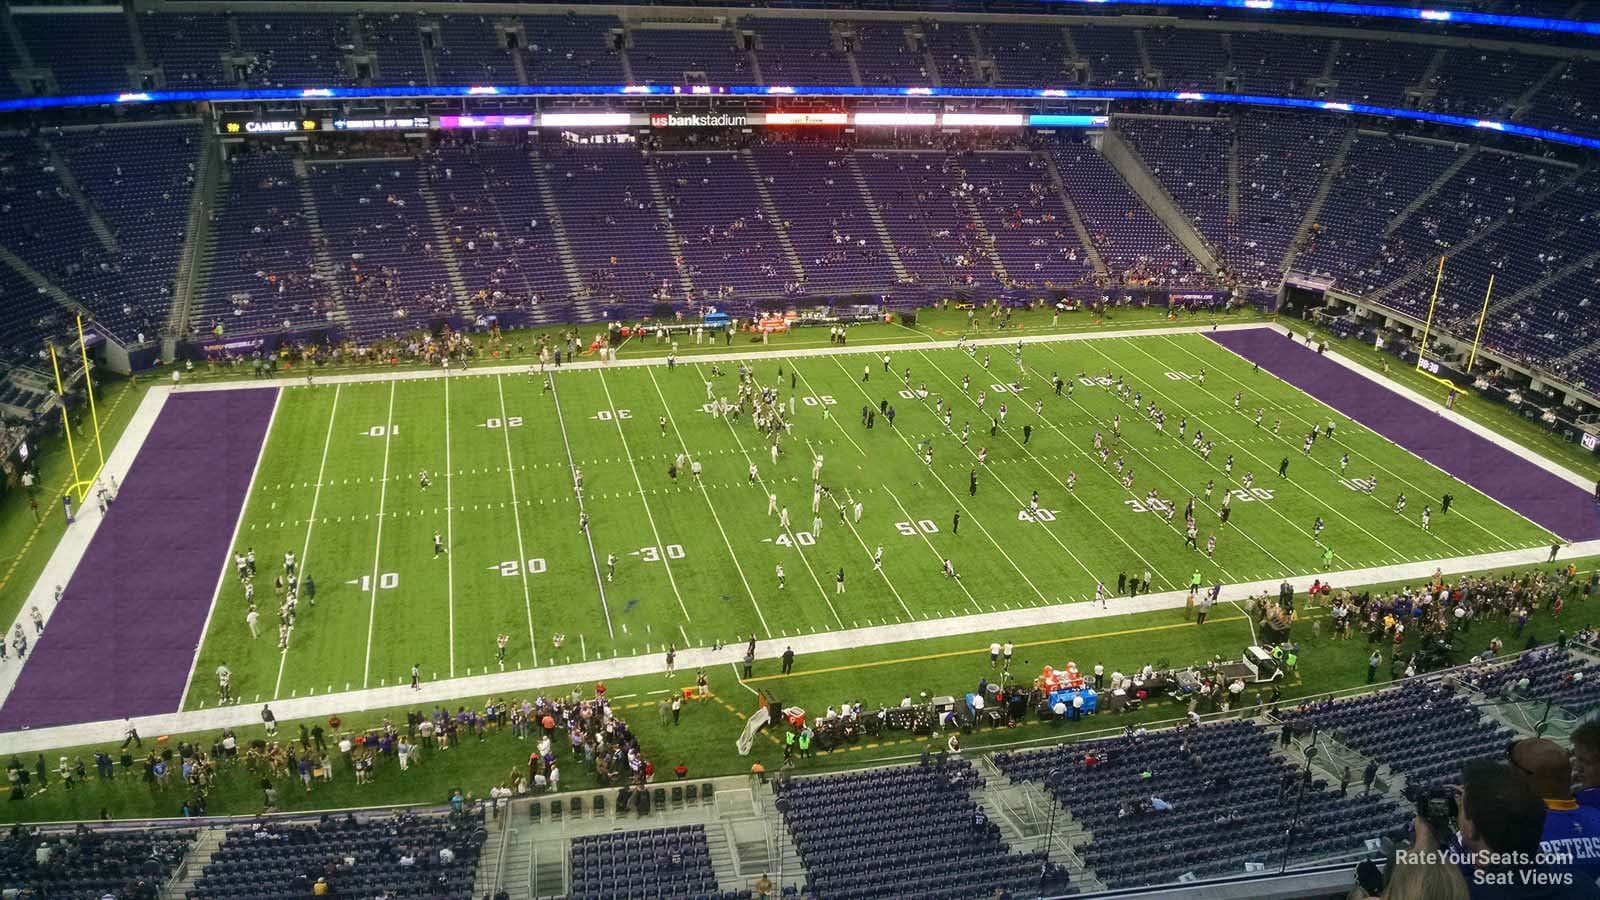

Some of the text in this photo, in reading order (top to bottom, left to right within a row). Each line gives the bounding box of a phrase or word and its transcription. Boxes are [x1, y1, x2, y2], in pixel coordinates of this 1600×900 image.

[895, 519, 940, 537] 50
[775, 531, 816, 548] 40
[640, 544, 686, 563] 30
[500, 558, 547, 577] 20
[361, 572, 400, 592] 10
